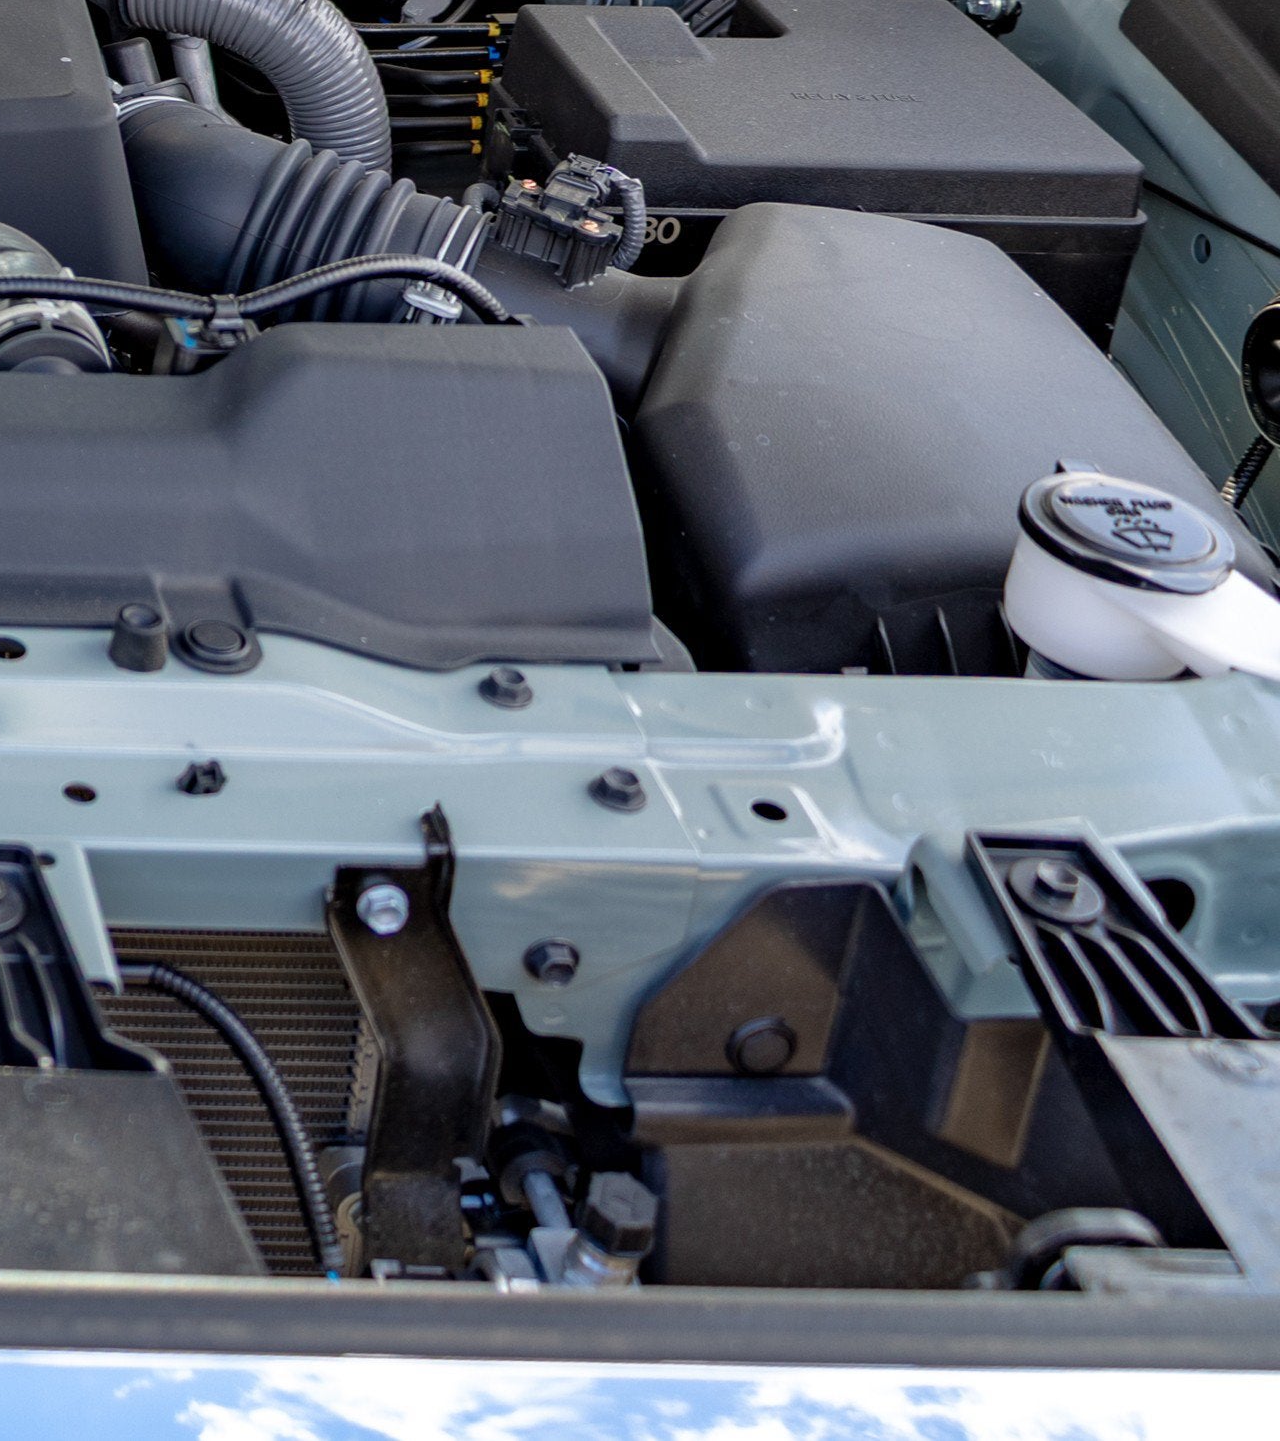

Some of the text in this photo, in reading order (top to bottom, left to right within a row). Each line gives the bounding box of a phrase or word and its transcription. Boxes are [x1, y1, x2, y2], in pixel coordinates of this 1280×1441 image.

[790, 91, 851, 101] RELAY
[870, 93, 924, 103] FUSE
[1058, 495, 1174, 511] WASHER FLUID
